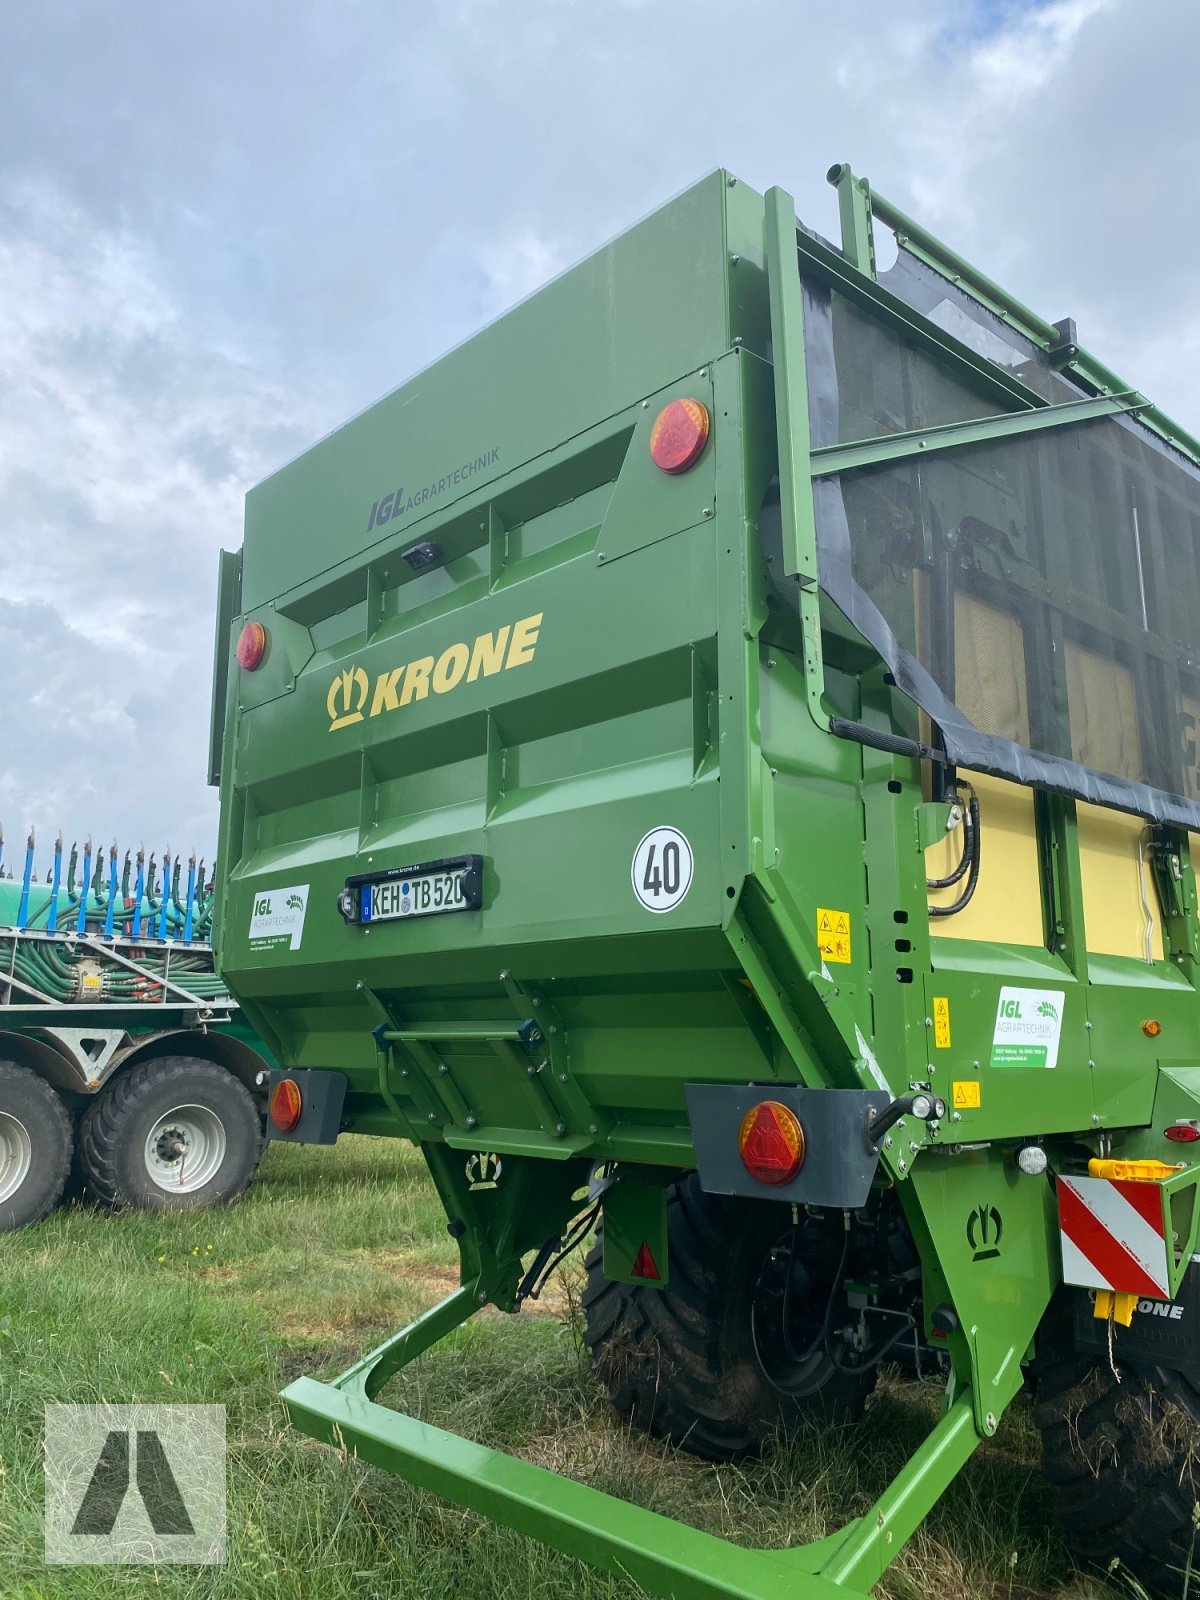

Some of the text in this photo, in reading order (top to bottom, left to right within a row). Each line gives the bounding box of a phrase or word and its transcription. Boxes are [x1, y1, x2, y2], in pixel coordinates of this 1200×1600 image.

[367, 446, 501, 532] IGL AGRARTECHNIK
[369, 612, 544, 718] KRONE
[643, 841, 680, 897] 40
[254, 898, 273, 917] IGL
[372, 874, 464, 916] KEH TB 520
[999, 999, 1023, 1019] IGL
[997, 1021, 1052, 1035] AGRARTECHNIK
[1137, 1300, 1185, 1320] ONE
